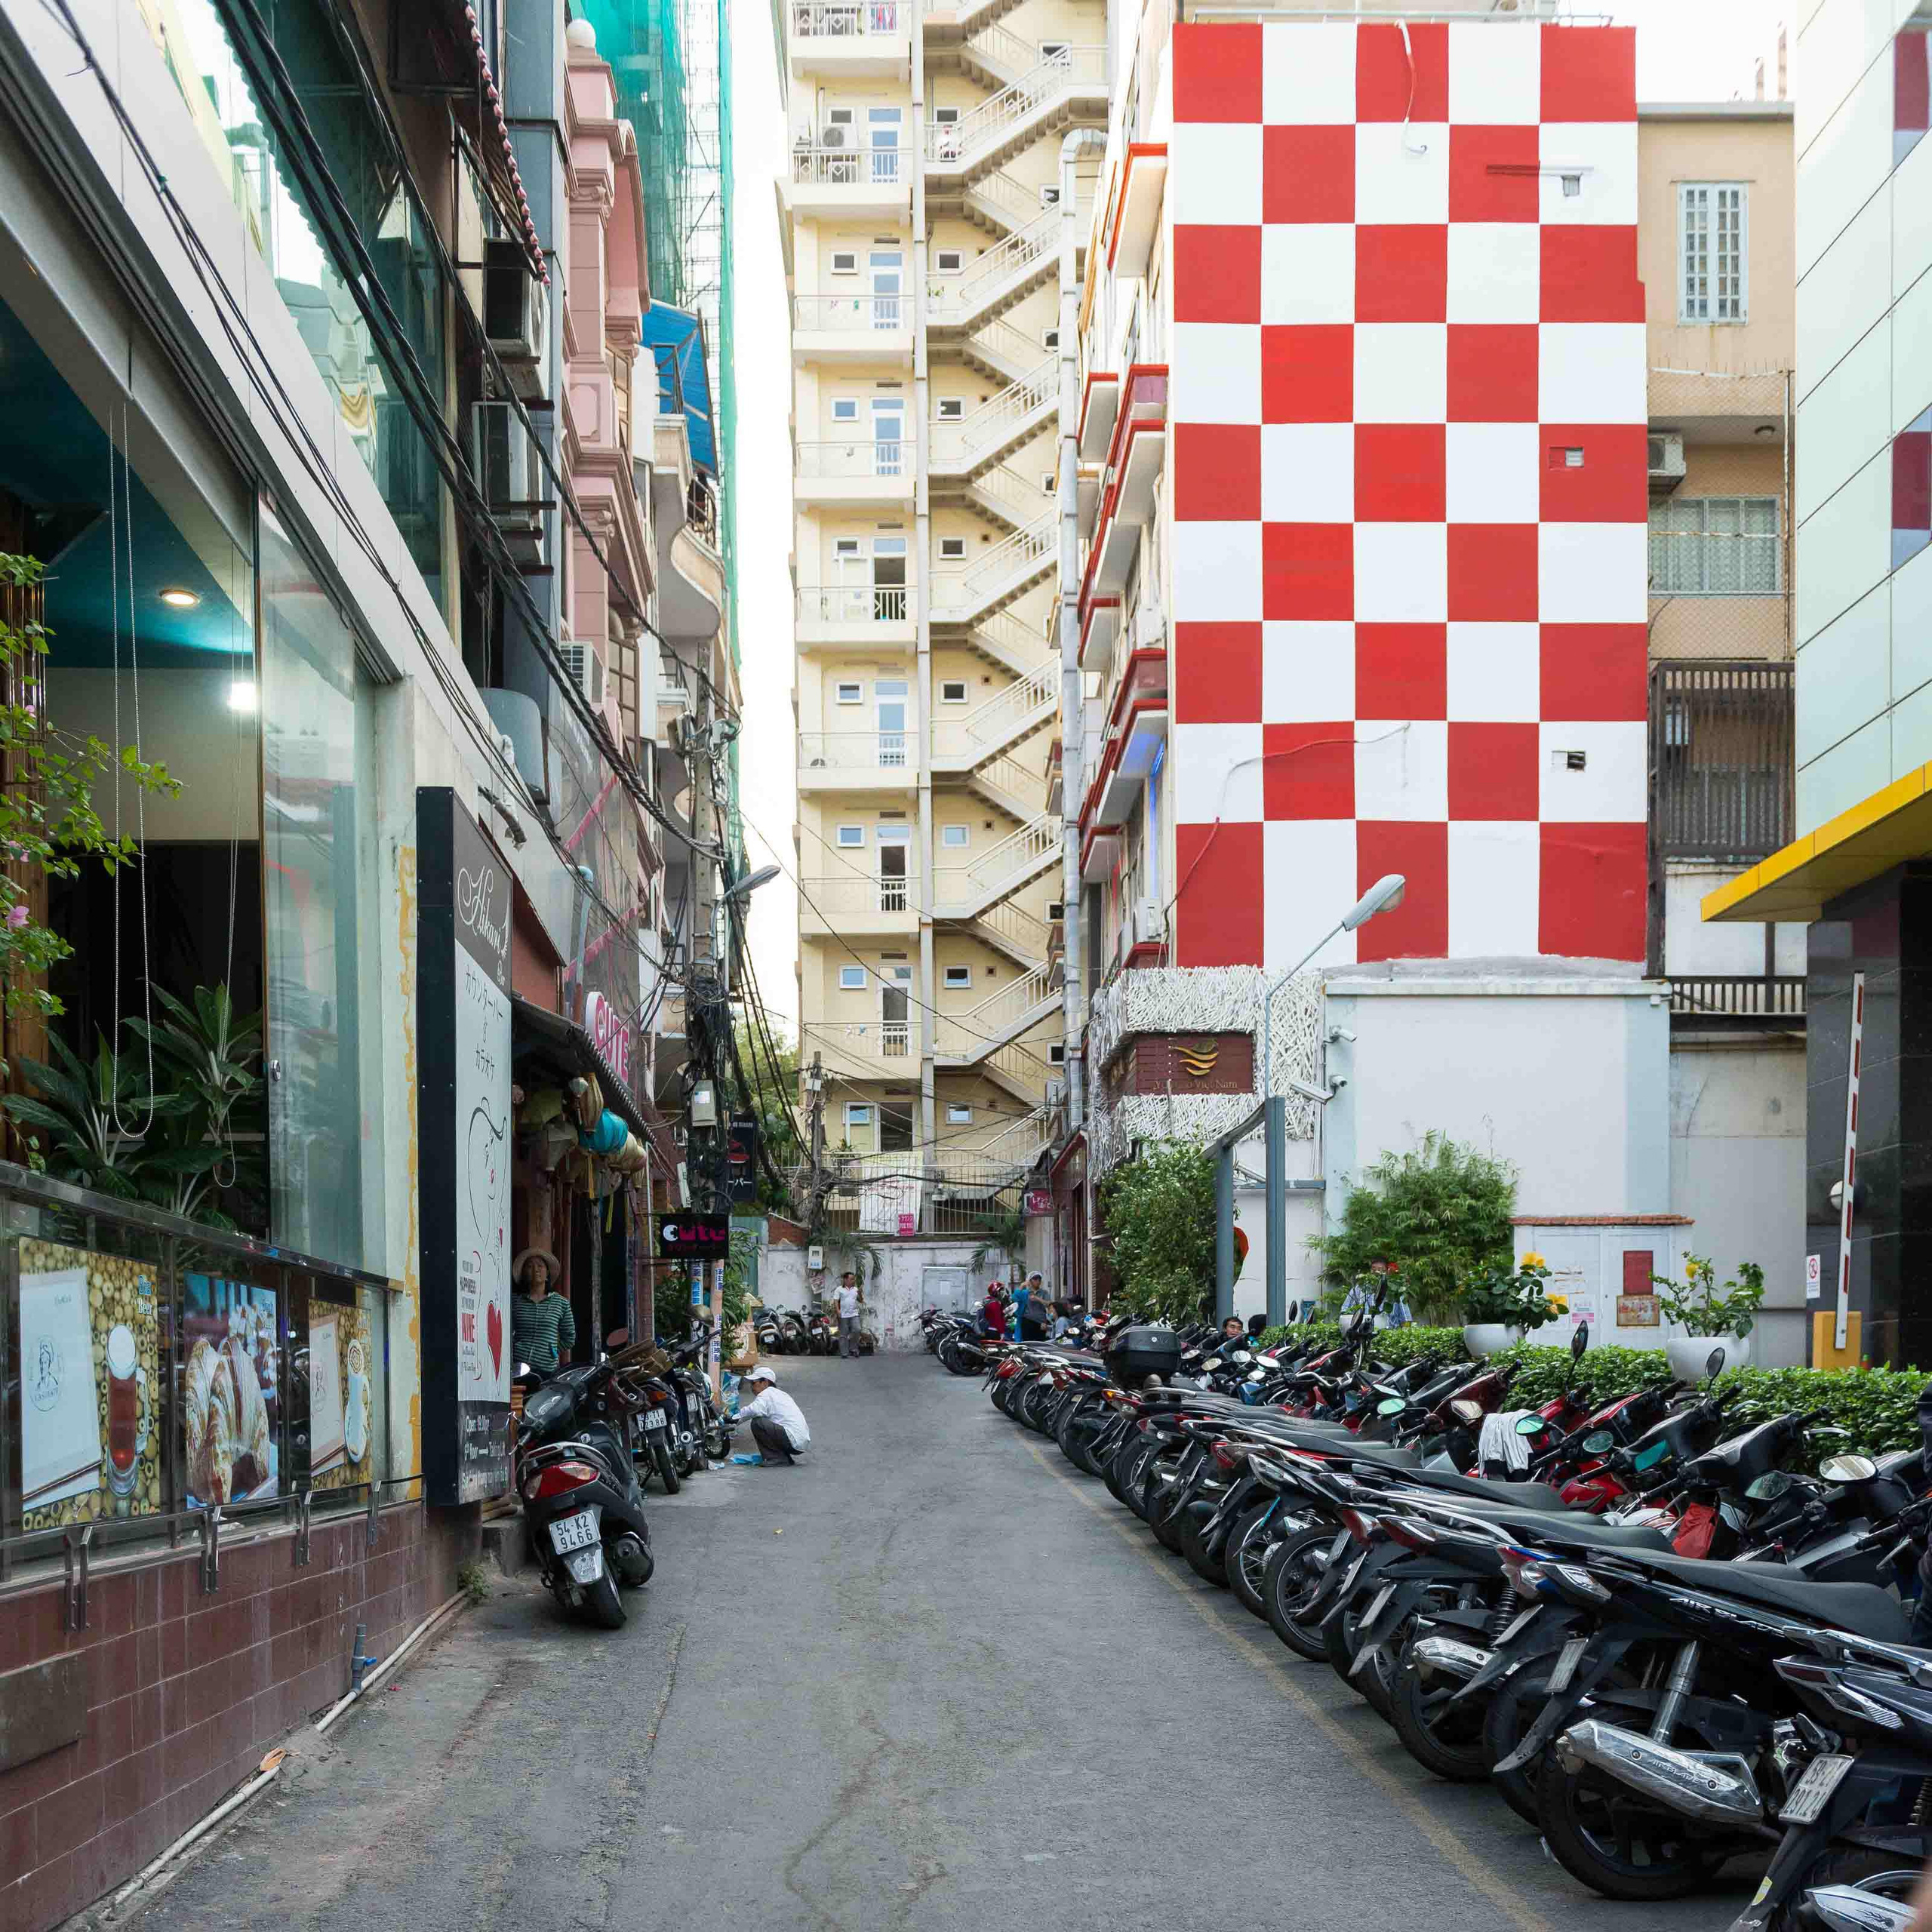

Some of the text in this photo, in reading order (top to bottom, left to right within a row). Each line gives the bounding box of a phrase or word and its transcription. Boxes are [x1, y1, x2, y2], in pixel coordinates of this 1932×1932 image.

[588, 992, 629, 1084] CUTE
[475, 1043, 496, 1083] カラオケ
[1214, 1079, 1238, 1090] Nam
[135, 1297, 153, 1315] Beer
[461, 1312, 475, 1343] WINE
[555, 1515, 589, 1537] 54-K2
[560, 1529, 593, 1549] 9466
